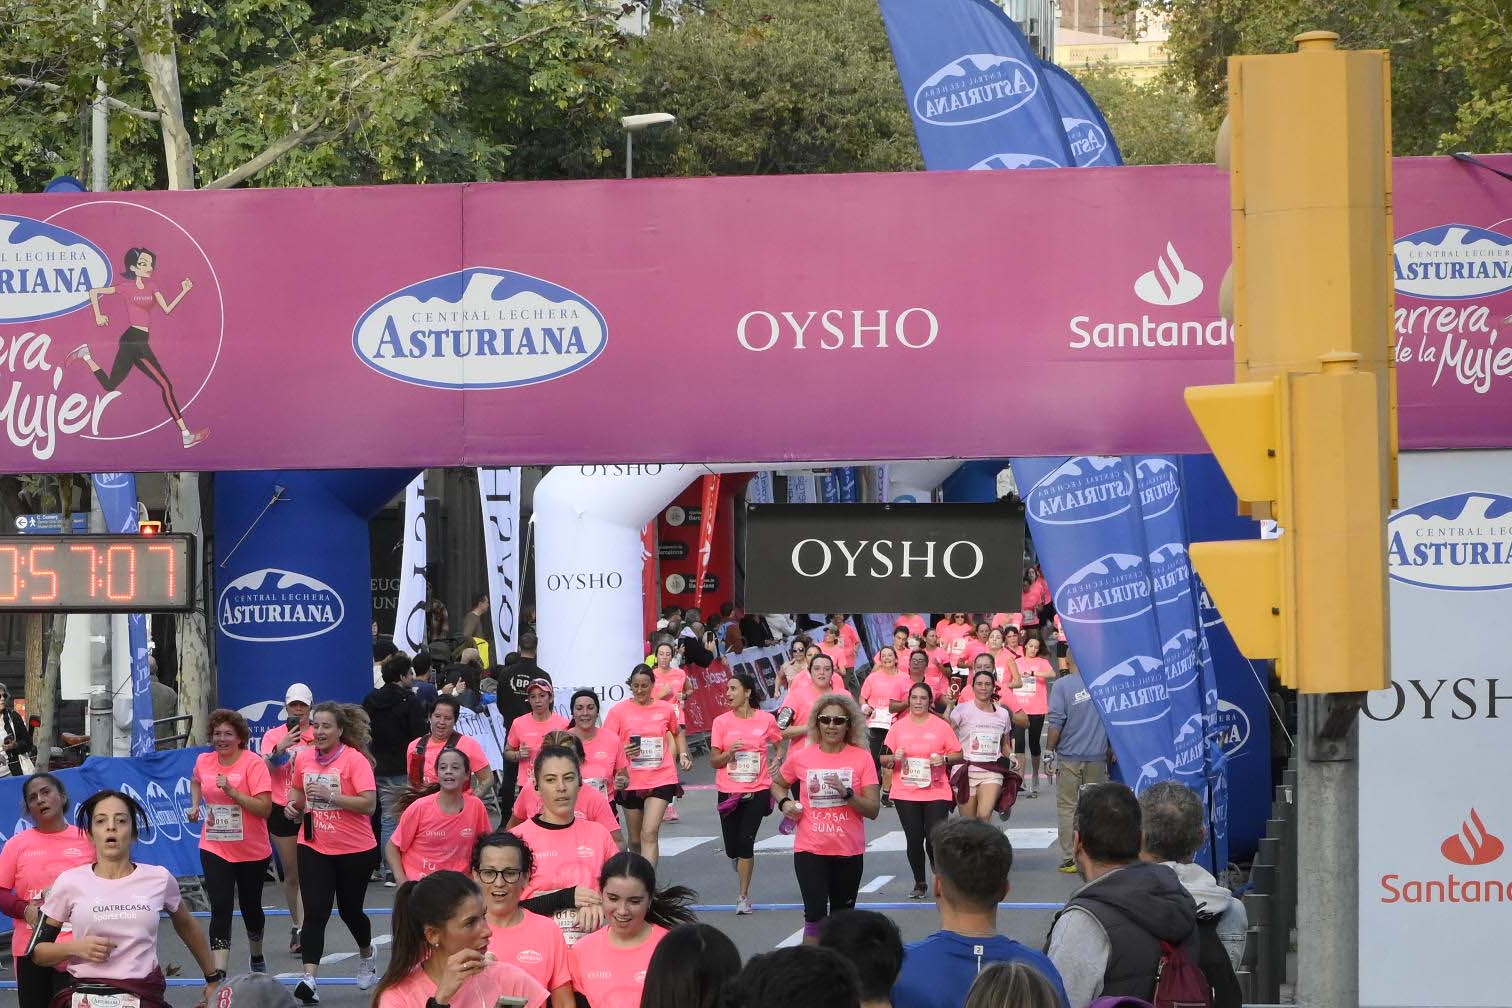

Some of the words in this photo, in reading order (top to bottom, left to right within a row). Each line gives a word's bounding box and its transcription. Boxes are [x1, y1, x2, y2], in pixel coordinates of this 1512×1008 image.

[15, 251, 88, 262] LECHERA
[411, 310, 491, 323] CENTRAL
[498, 308, 580, 321] LECHERA
[736, 307, 940, 352] OYSHO
[1394, 304, 1491, 333] arrera
[373, 315, 588, 359] ASTURIANA
[1069, 315, 1236, 349] Santand
[1418, 334, 1436, 363] la
[1432, 328, 1512, 394] Muje
[1416, 526, 1484, 538] CENTRAL
[791, 538, 984, 579] OYSHO
[547, 572, 622, 591] OYSHO
[222, 598, 335, 626] ASTURIANA
[1381, 874, 1512, 904] Santan
[93, 904, 152, 913] CUATRECASAS
